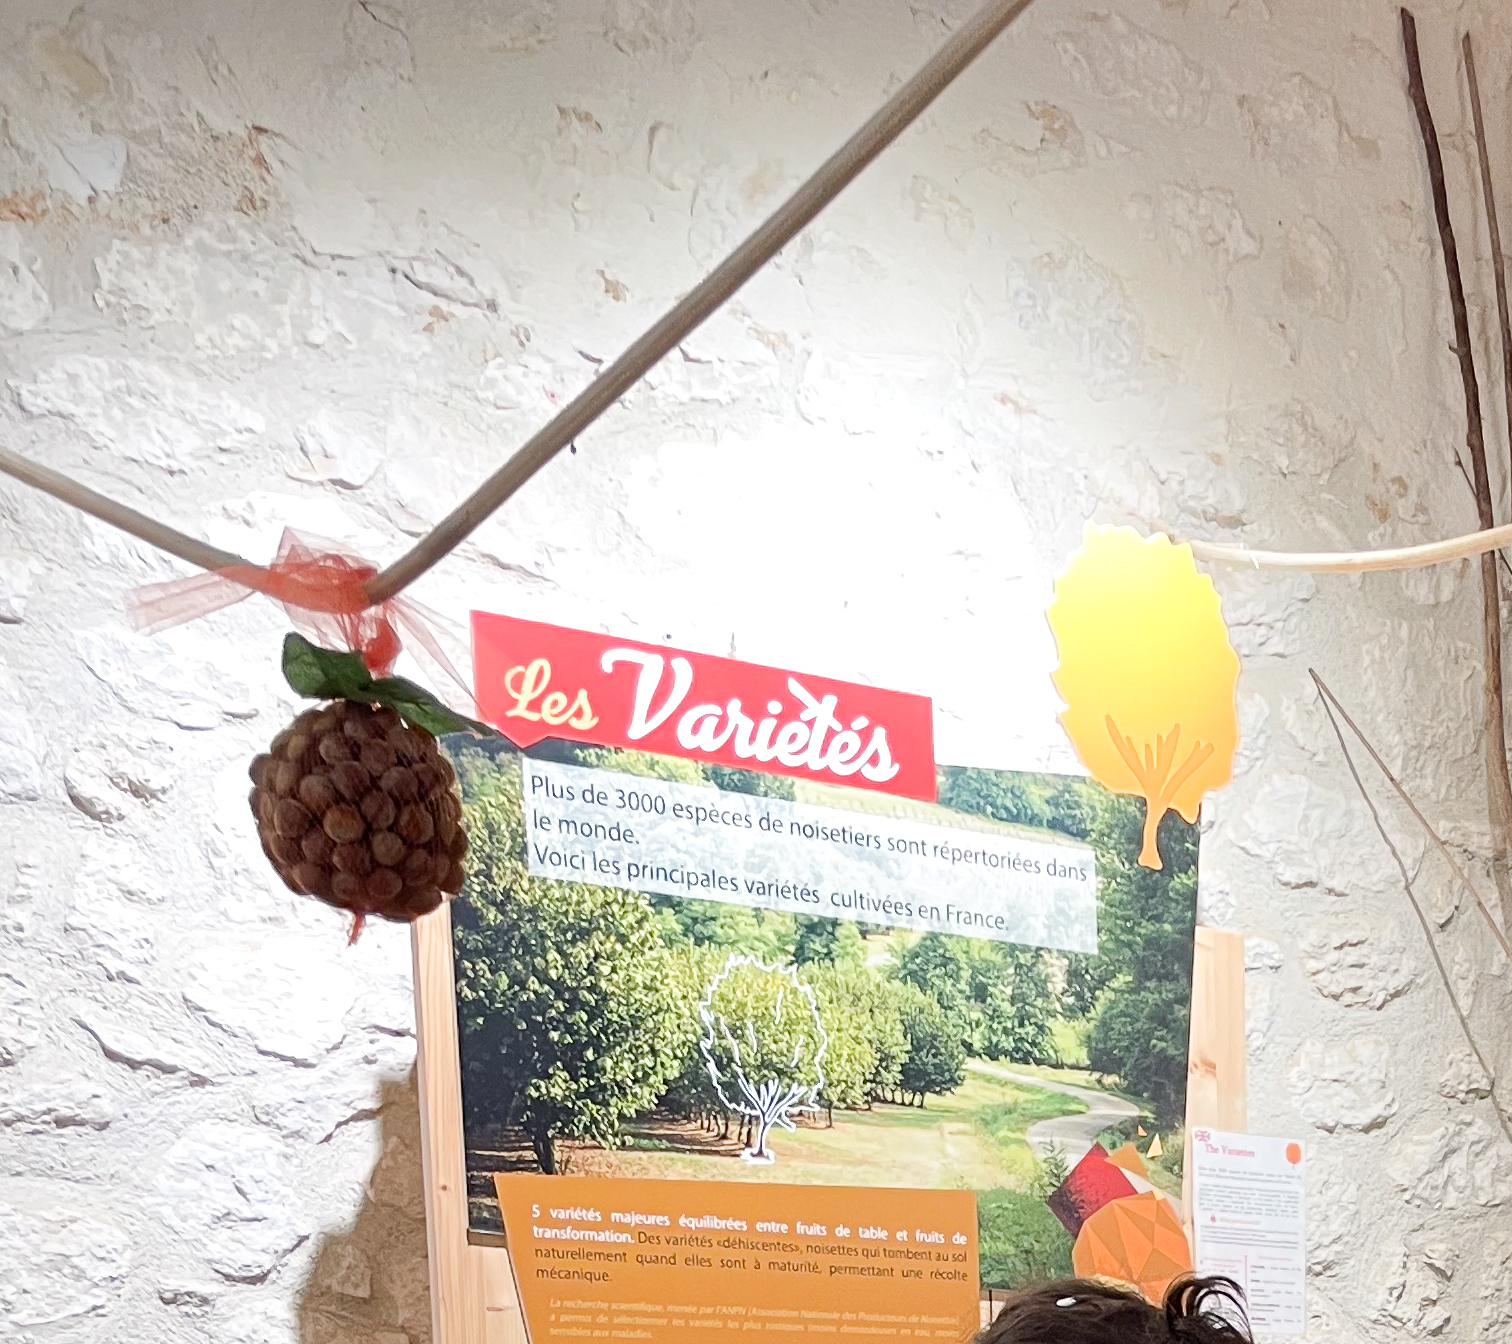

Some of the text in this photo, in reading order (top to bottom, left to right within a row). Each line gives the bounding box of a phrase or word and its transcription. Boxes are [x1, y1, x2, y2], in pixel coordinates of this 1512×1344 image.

[504, 649, 899, 782] Les Variétés
[532, 775, 1087, 881] Plus de 3000 espèces de noisetiers sont répertoriées dans
[534, 809, 638, 845] le monde.
[534, 842, 1008, 931] Voici les principales variétés cultivées en France.
[532, 1205, 967, 1245] 5 variétés majeures équilibrées entre fruits de table et fruits de
[533, 1226, 634, 1244] transformation.
[638, 1232, 661, 1245] Des
[664, 1232, 713, 1248] variétés
[806, 1242, 859, 1257] noisettes
[861, 1245, 880, 1261] qui
[935, 1250, 948, 1261] au
[952, 1249, 967, 1263] sol
[535, 1247, 627, 1263] naturellement
[636, 1252, 676, 1268] quand
[684, 1254, 712, 1268] elles
[720, 1256, 746, 1269] sont
[754, 1258, 761, 1270] à
[829, 1263, 895, 1279] permettant
[902, 1268, 923, 1279] une
[930, 1266, 968, 1282] récolte
[536, 1266, 612, 1286] mécanique.
